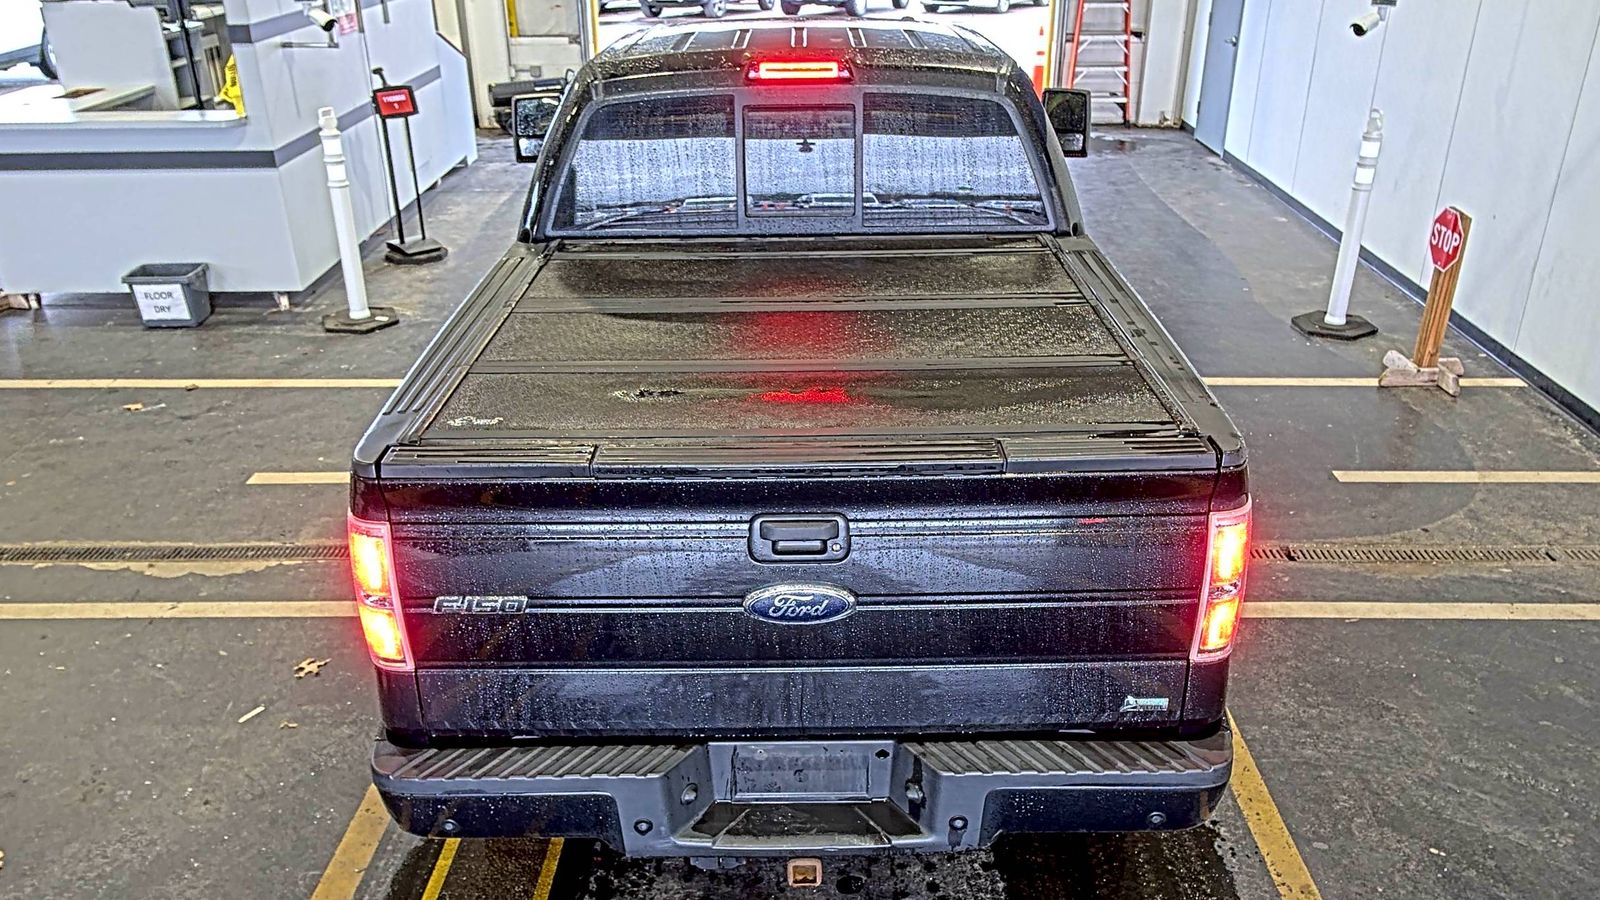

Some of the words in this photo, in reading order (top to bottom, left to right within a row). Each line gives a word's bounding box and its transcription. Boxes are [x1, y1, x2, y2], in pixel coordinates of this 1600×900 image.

[1431, 222, 1460, 255] STOP
[143, 291, 175, 300] FLOOR
[153, 305, 171, 313] DRY
[768, 594, 829, 617] Ford
